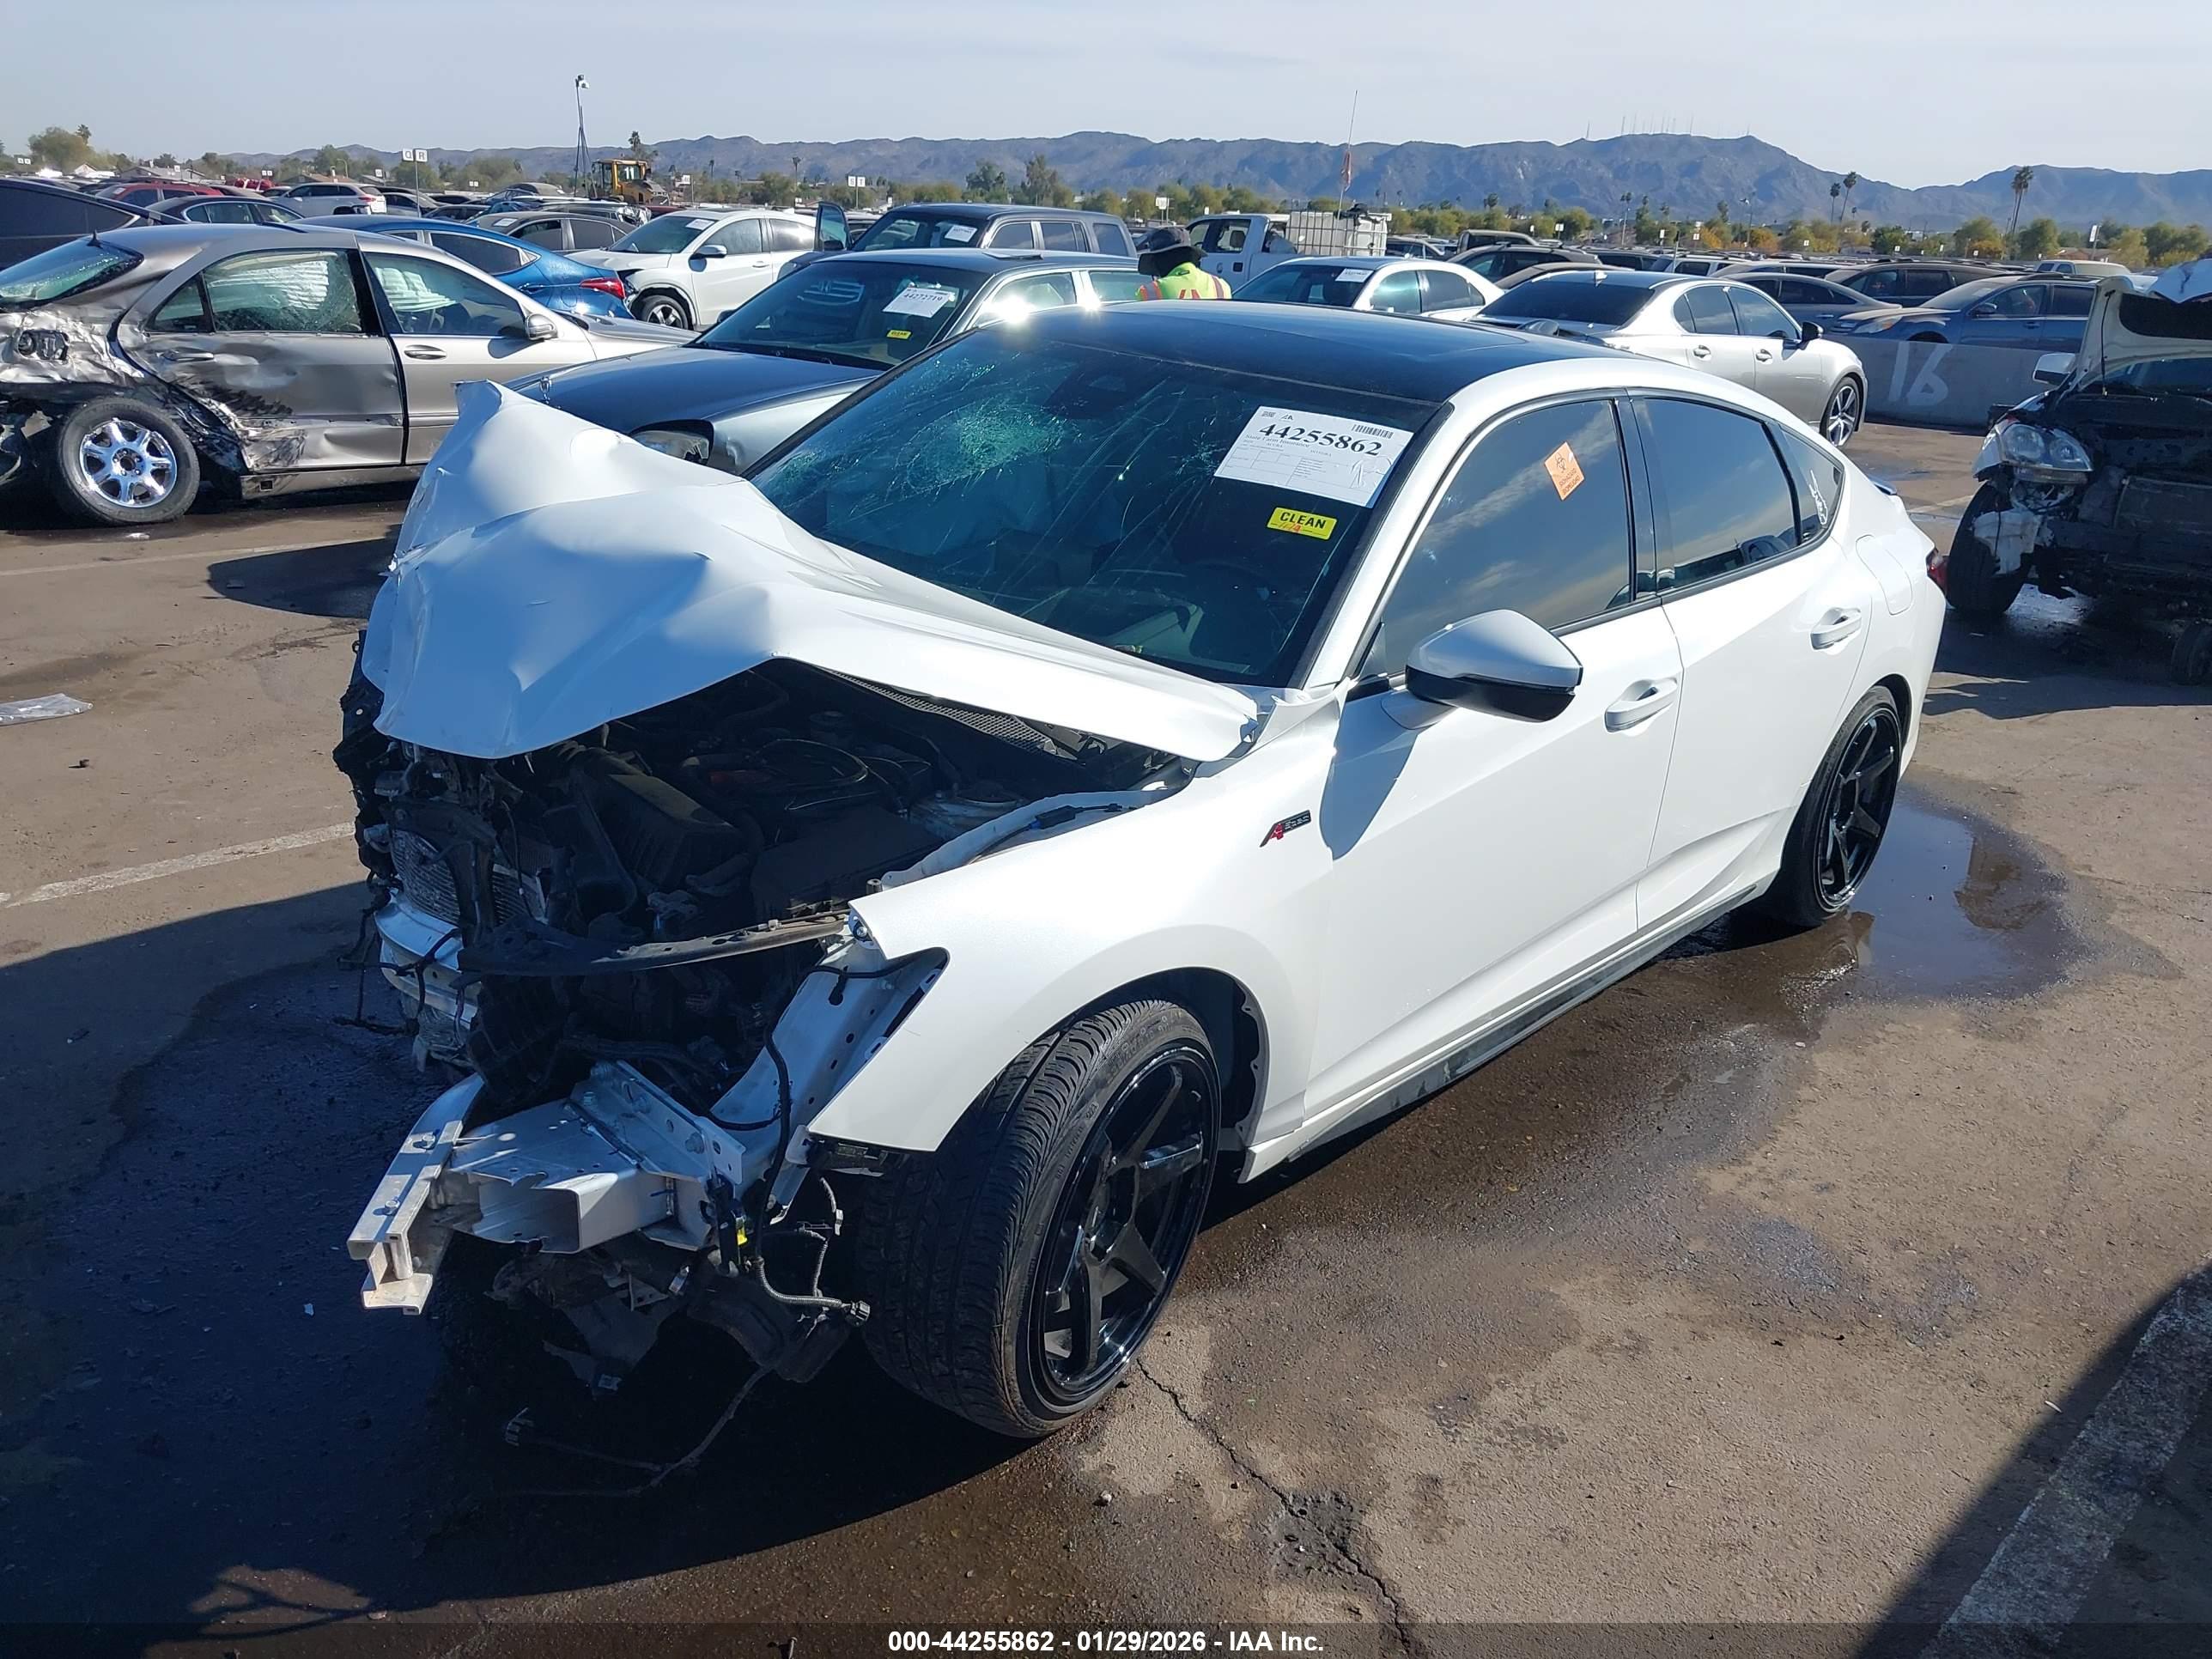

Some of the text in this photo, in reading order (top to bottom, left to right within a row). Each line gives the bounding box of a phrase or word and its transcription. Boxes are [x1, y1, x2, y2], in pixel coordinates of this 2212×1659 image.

[418, 151, 425, 161] R
[1887, 341, 1954, 406] 16
[1259, 423, 1382, 456] 44255862
[1279, 512, 1327, 529] CLEAN
